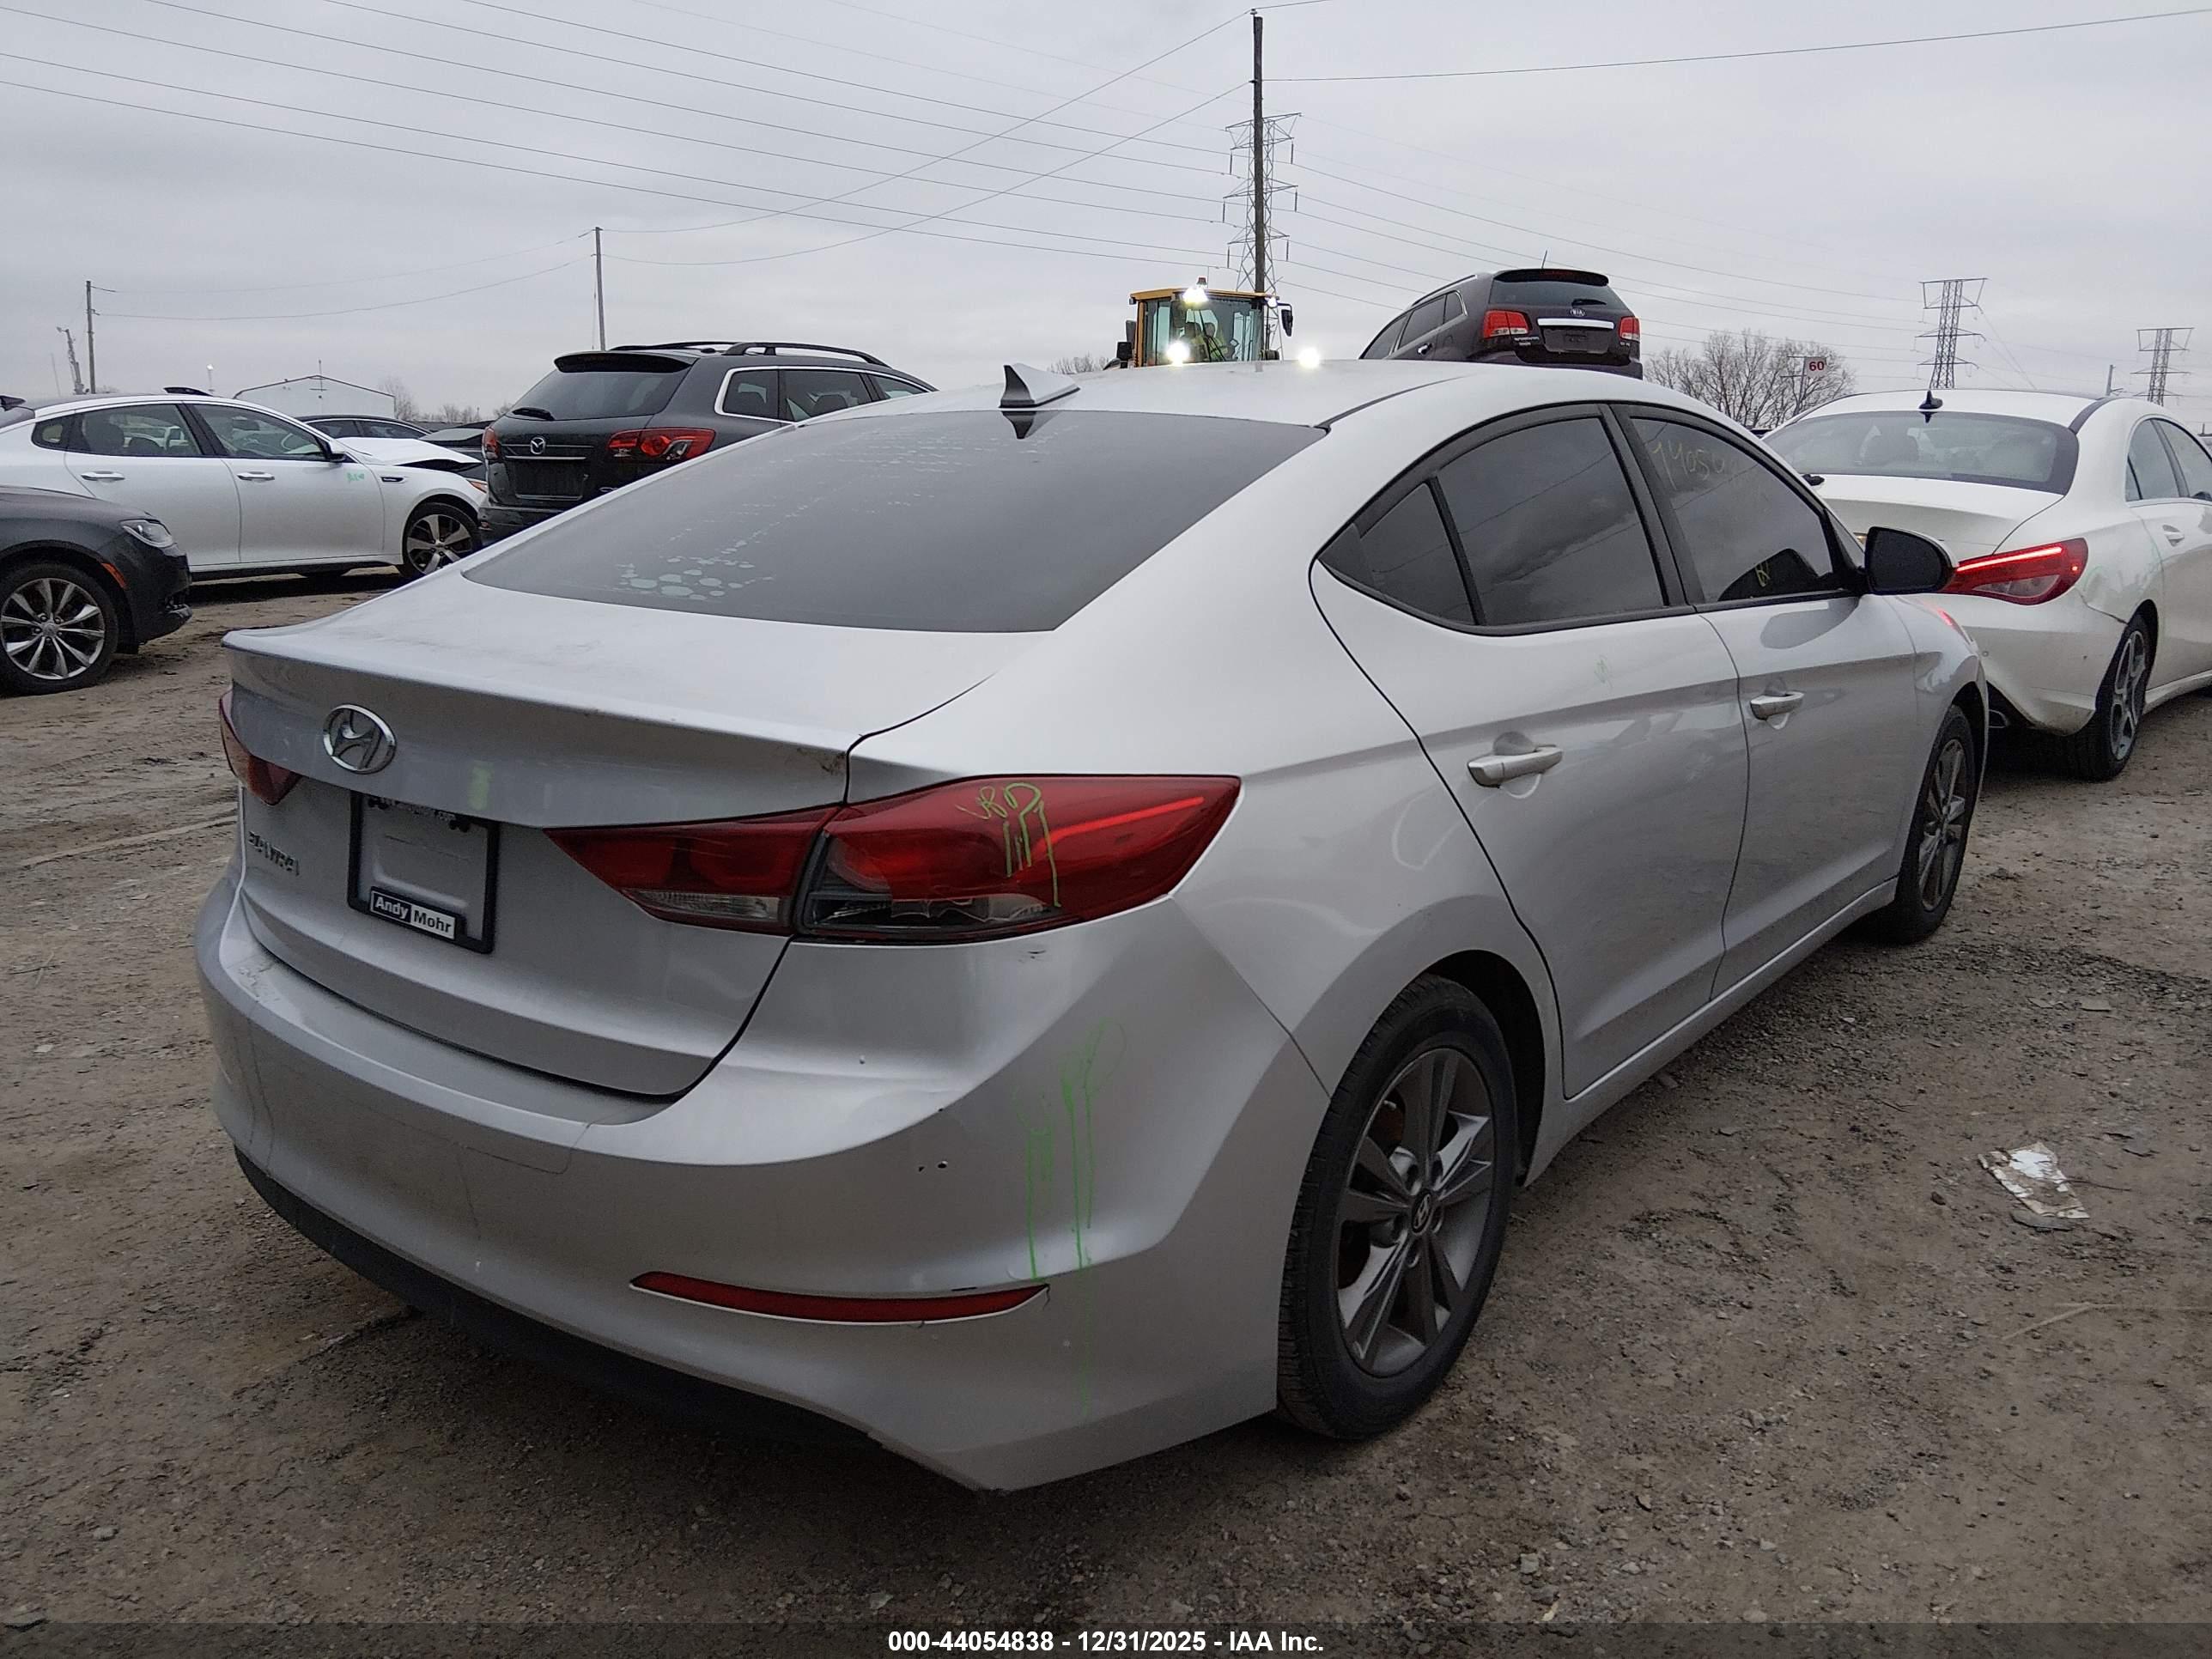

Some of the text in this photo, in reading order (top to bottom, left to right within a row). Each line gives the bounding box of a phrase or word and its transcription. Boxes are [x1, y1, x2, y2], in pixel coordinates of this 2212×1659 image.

[1809, 361, 1824, 371] 60
[375, 896, 452, 933] Andy Mohr
